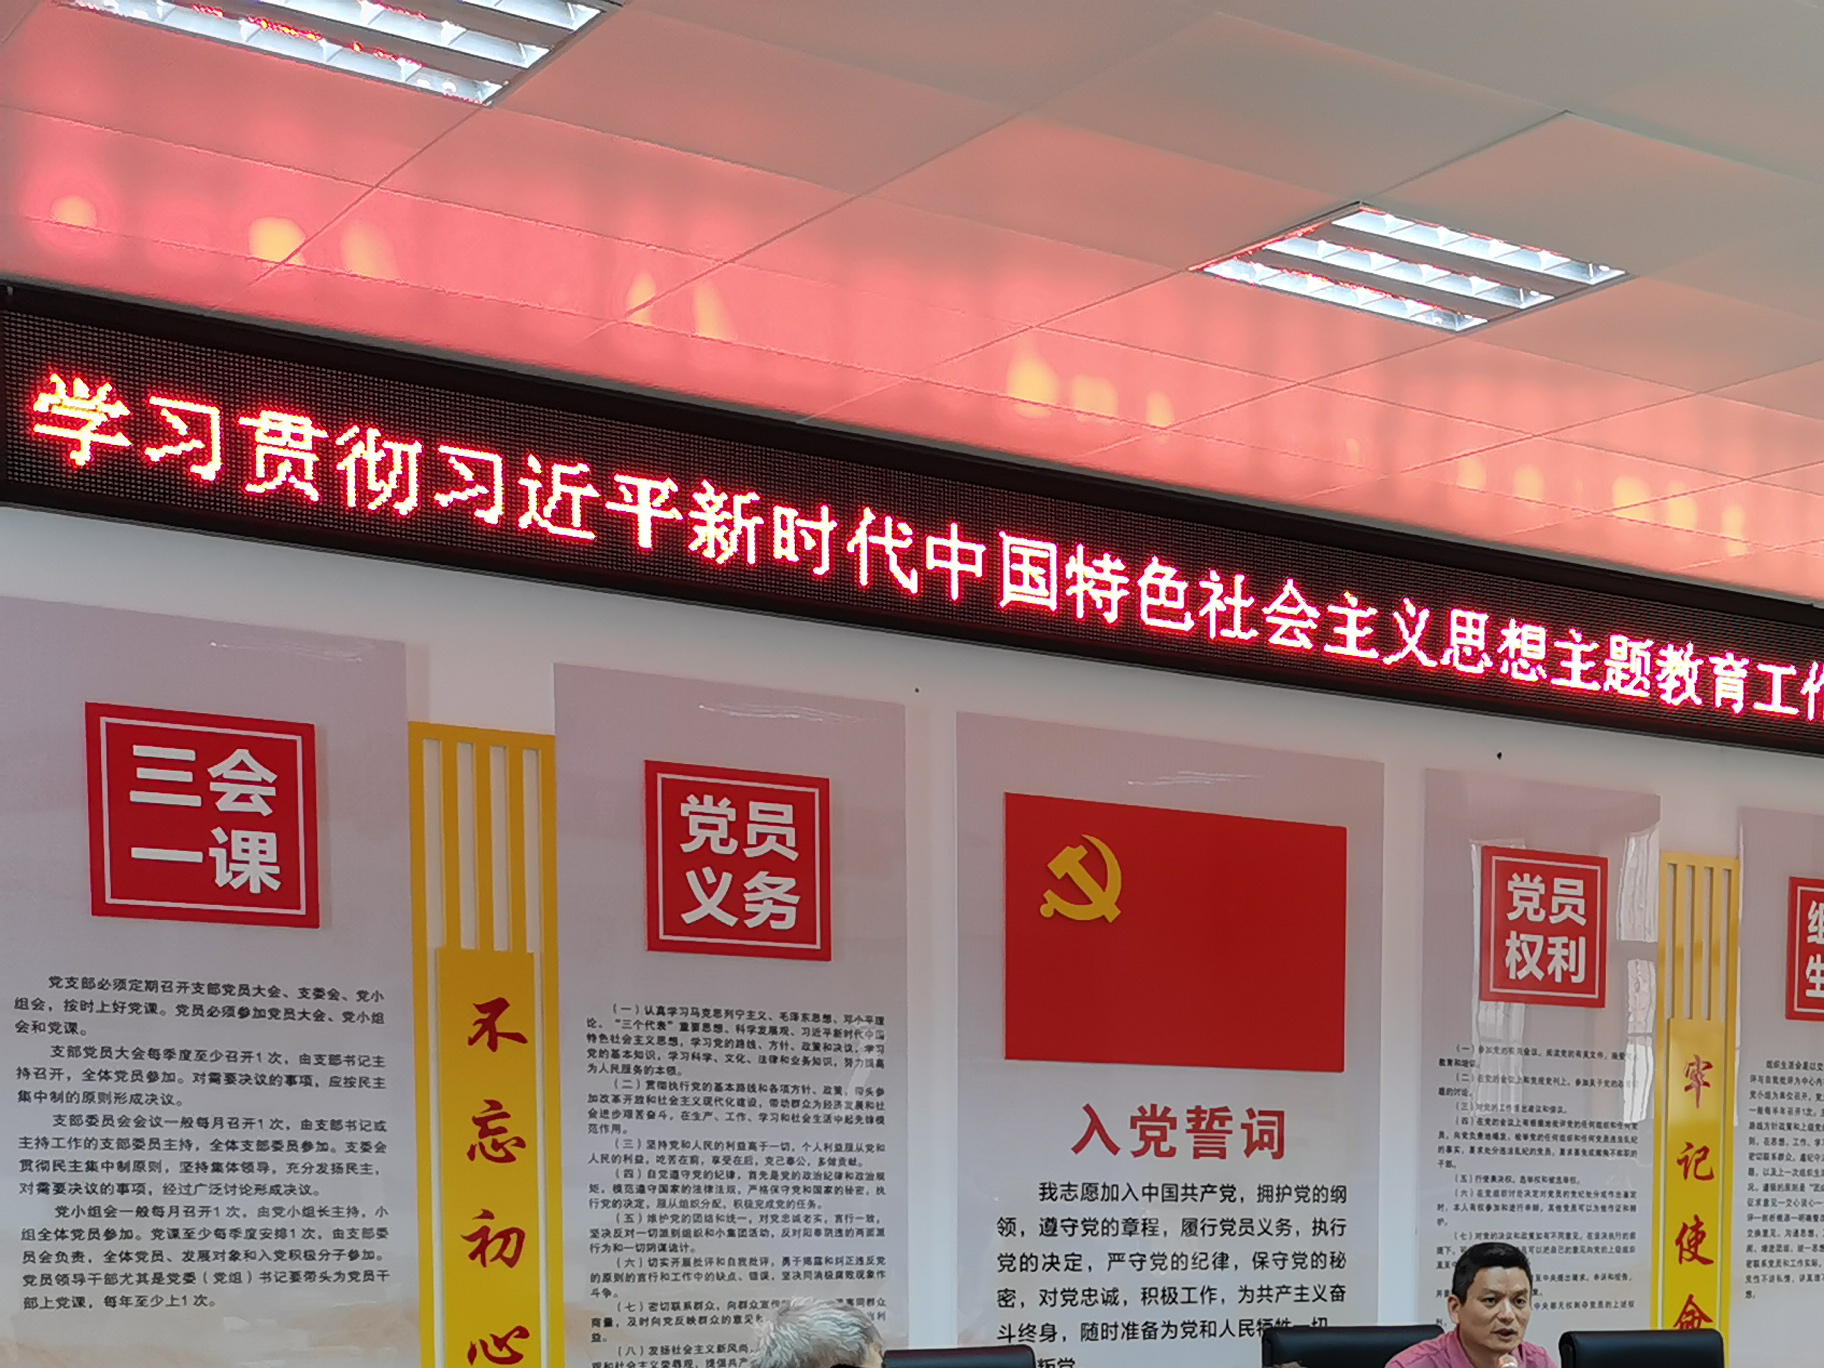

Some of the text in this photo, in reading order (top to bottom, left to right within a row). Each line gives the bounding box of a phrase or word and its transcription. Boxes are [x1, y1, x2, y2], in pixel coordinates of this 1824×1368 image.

[130, 745, 277, 816] 三会
[680, 794, 799, 861] 党员
[131, 826, 281, 894] 一课
[680, 867, 800, 931] 义务
[1506, 872, 1587, 926] 党员
[1505, 931, 1587, 984] 权利
[14, 1020, 87, 1036] 会和党课。
[17, 1090, 183, 1107] 集中制的原则形成决议。
[1071, 1103, 1286, 1160] 入党誓词
[460, 996, 530, 1368] 不忘初心
[1039, 1182, 1347, 1204] 我志愿加入中国共产党，拥护党的纲
[1673, 1054, 1715, 1329] 牢记使命
[996, 1217, 1347, 1239] 领，遵守党的章程，履行党员义务，执行
[996, 1251, 1347, 1273] 党的决定，严守党的纪律，保守党的秘
[996, 1284, 1346, 1309] 密，对党忠诚，积极工作，为共产主义奋
